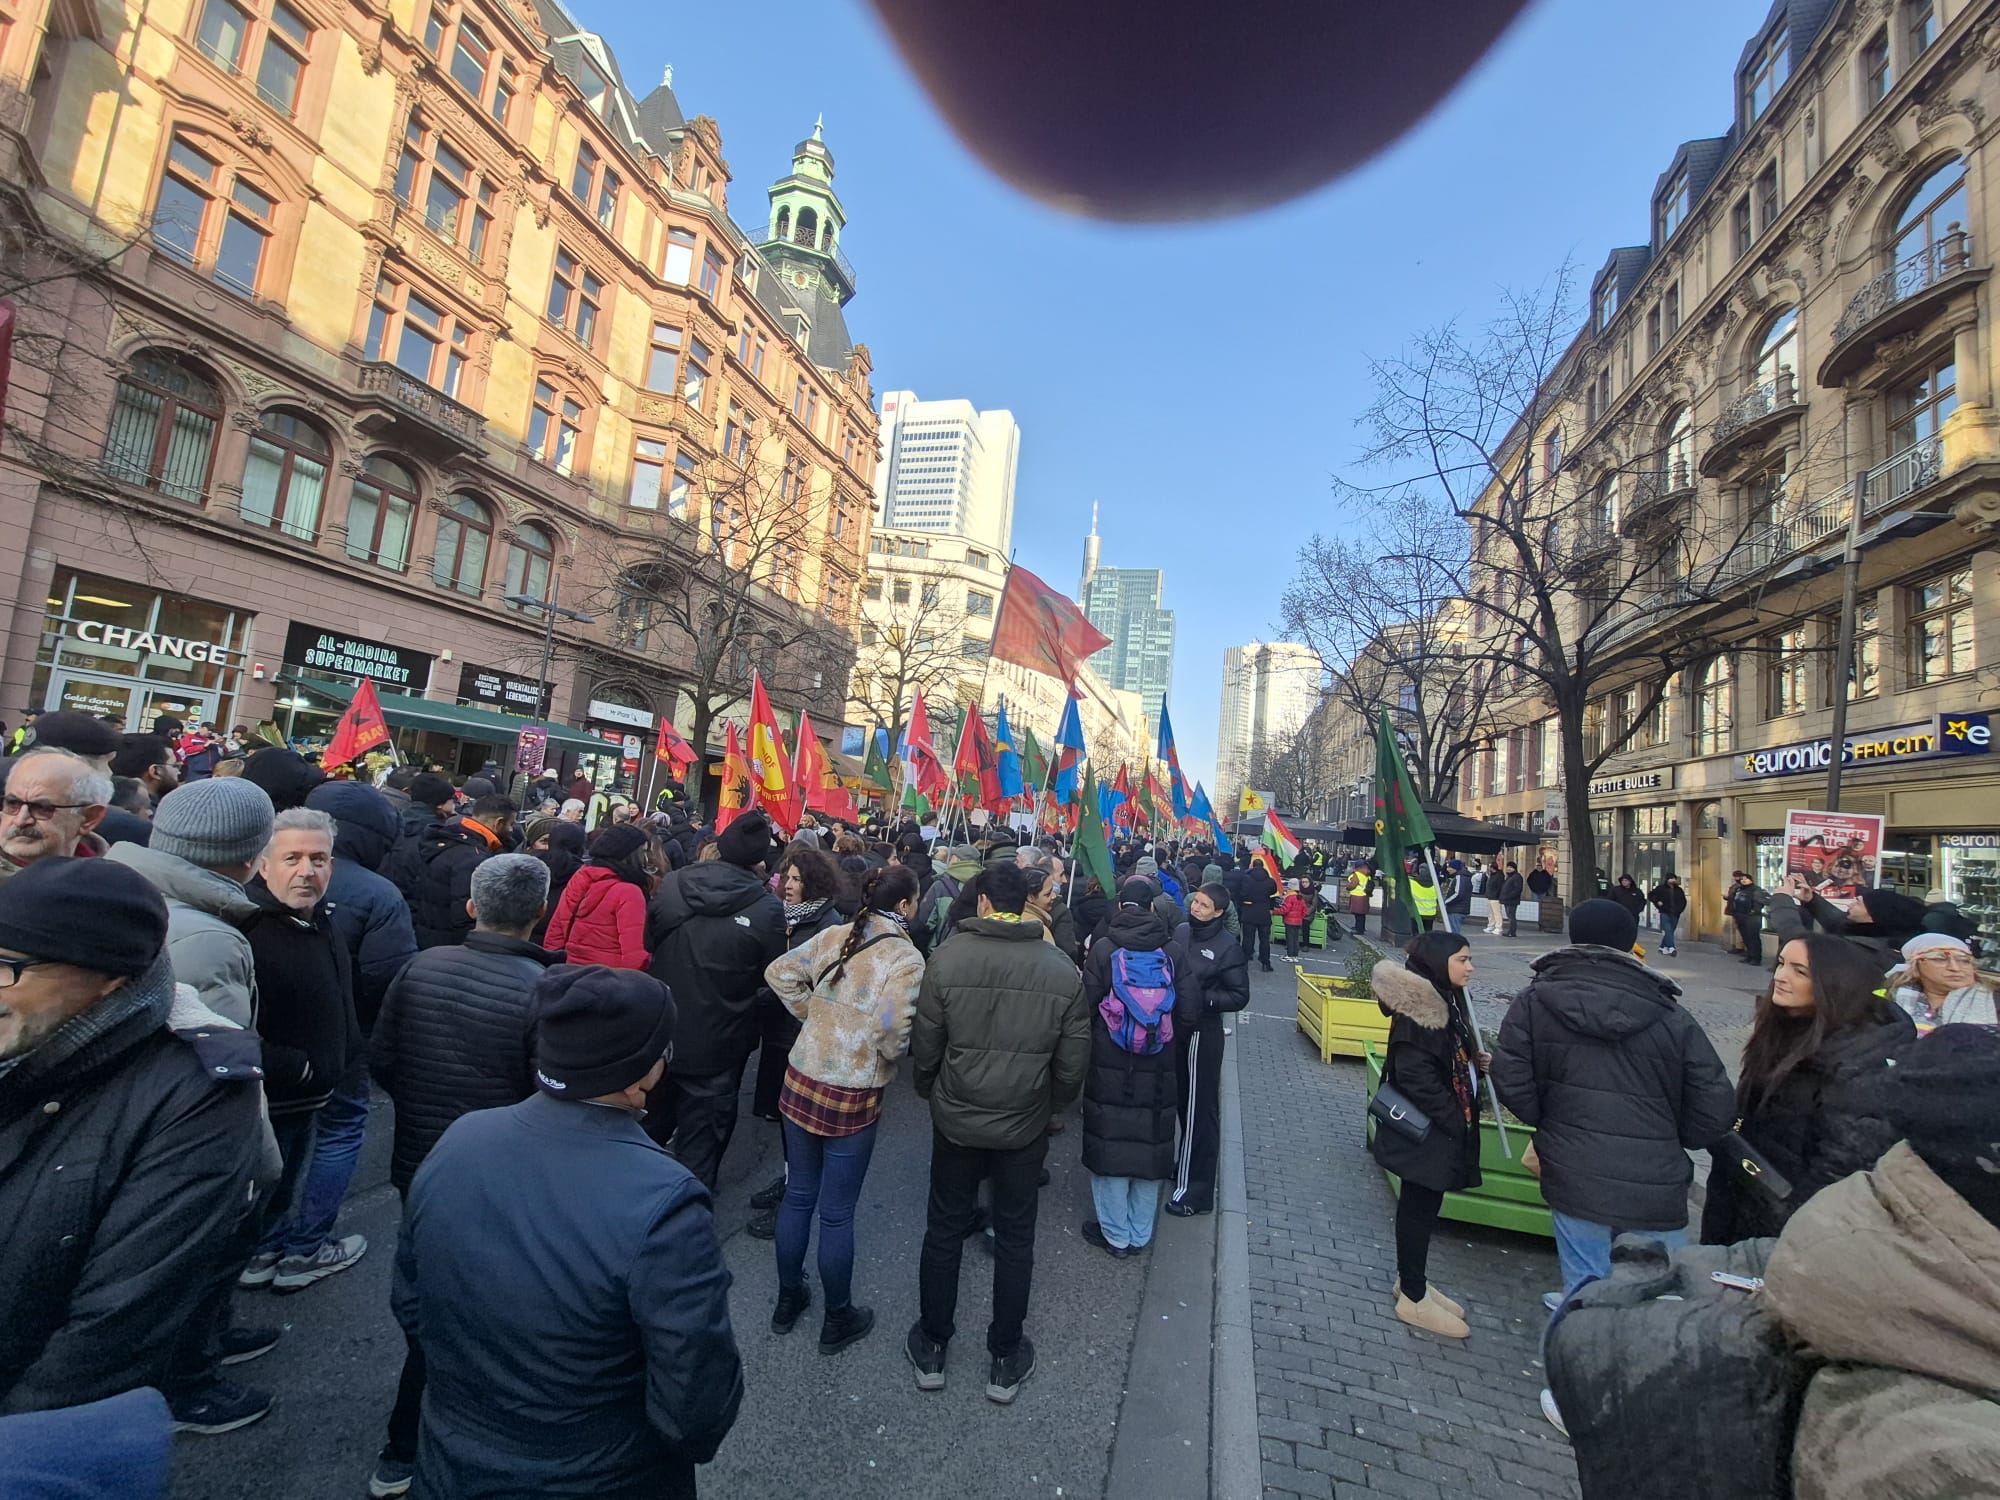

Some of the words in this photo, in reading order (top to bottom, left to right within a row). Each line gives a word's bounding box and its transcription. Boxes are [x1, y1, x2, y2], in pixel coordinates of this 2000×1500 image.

[77, 621, 227, 665] CHANGE
[317, 634, 398, 665] AL-MADINA
[305, 648, 410, 682] SUPERMARKET
[506, 681, 546, 697] ORIENTALISCE
[63, 693, 87, 702] Geld
[88, 698, 124, 708] dorthin
[1967, 726, 1991, 745] e
[1854, 743, 1889, 759] FFM
[1893, 736, 1935, 755] CITY
[1597, 779, 1623, 793] FETTE
[1625, 774, 1655, 790] BULLE
[1823, 828, 1865, 840] Stadt
